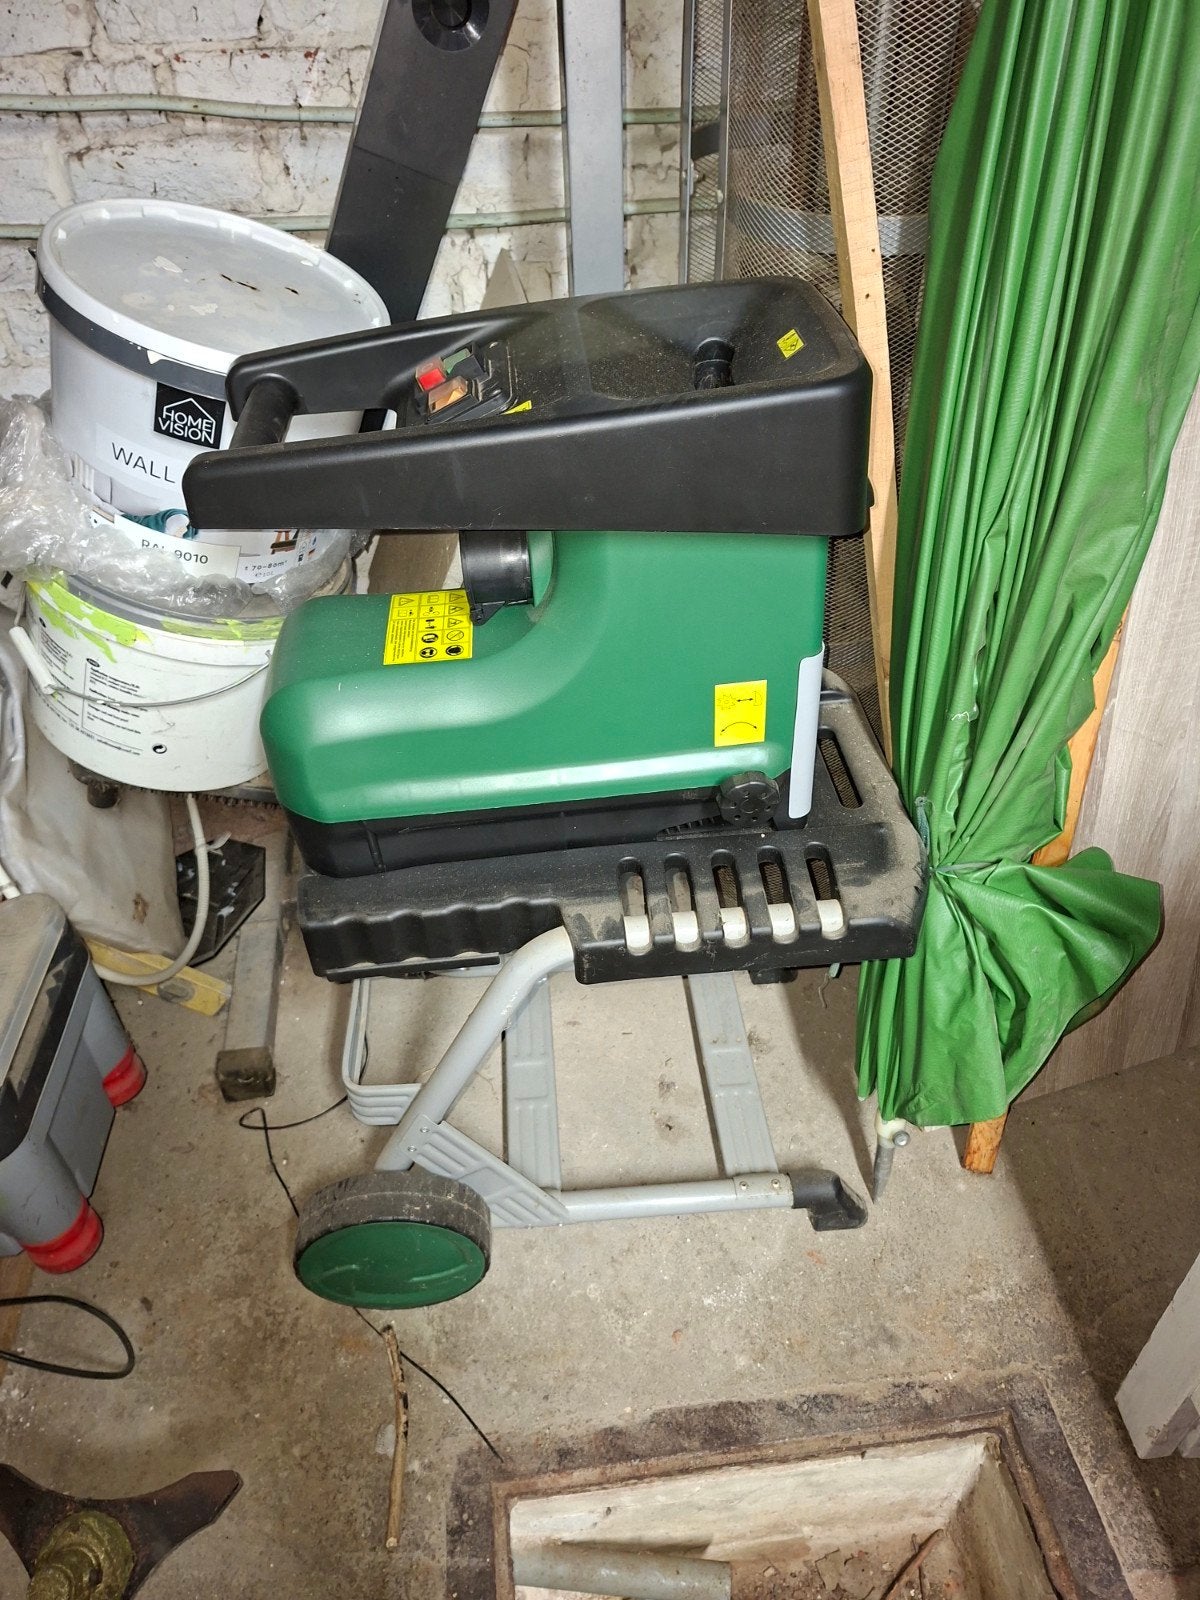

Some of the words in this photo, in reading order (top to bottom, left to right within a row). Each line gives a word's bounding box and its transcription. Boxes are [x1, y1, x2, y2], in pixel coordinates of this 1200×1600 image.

[158, 417, 214, 444] VISION
[162, 408, 214, 432] HOME
[111, 442, 176, 483] WALL
[174, 549, 209, 564] 9010
